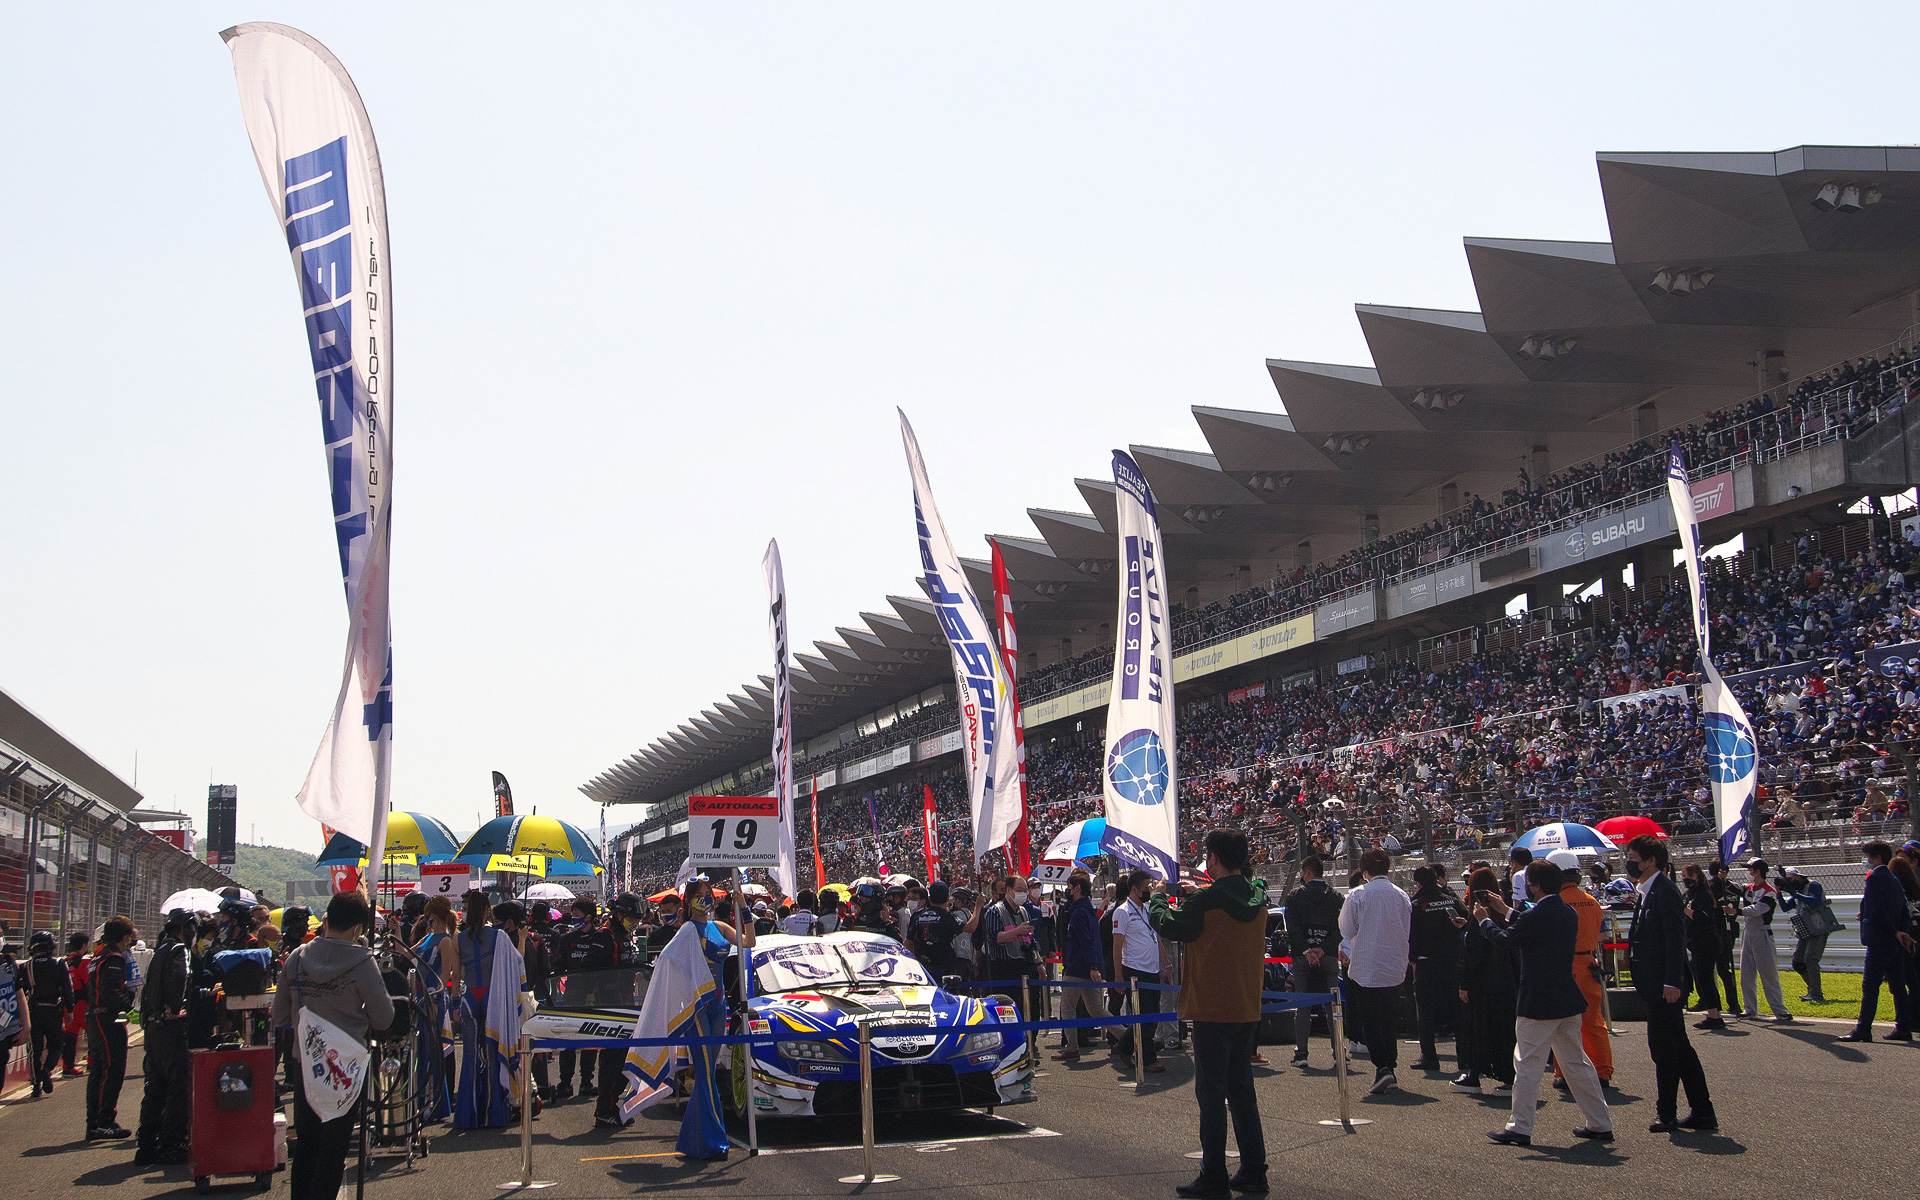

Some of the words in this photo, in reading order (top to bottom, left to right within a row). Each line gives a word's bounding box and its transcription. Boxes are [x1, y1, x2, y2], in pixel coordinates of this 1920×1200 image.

[1592, 516, 1646, 546] SUBARU
[1410, 583, 1427, 595] TOYOTA
[1259, 627, 1297, 650] DUNLOP
[1190, 650, 1223, 672] DUNLOP
[1082, 687, 1107, 705] DUNLOP
[1036, 703, 1059, 718] DUNLOP
[707, 802, 776, 810] AUTOBACS
[711, 818, 758, 850] 19
[521, 846, 565, 855] WedsSport
[722, 853, 751, 861] WedsSport
[1044, 866, 1065, 879] 37
[438, 876, 452, 893] 3
[836, 1009, 949, 1026] WedsSport
